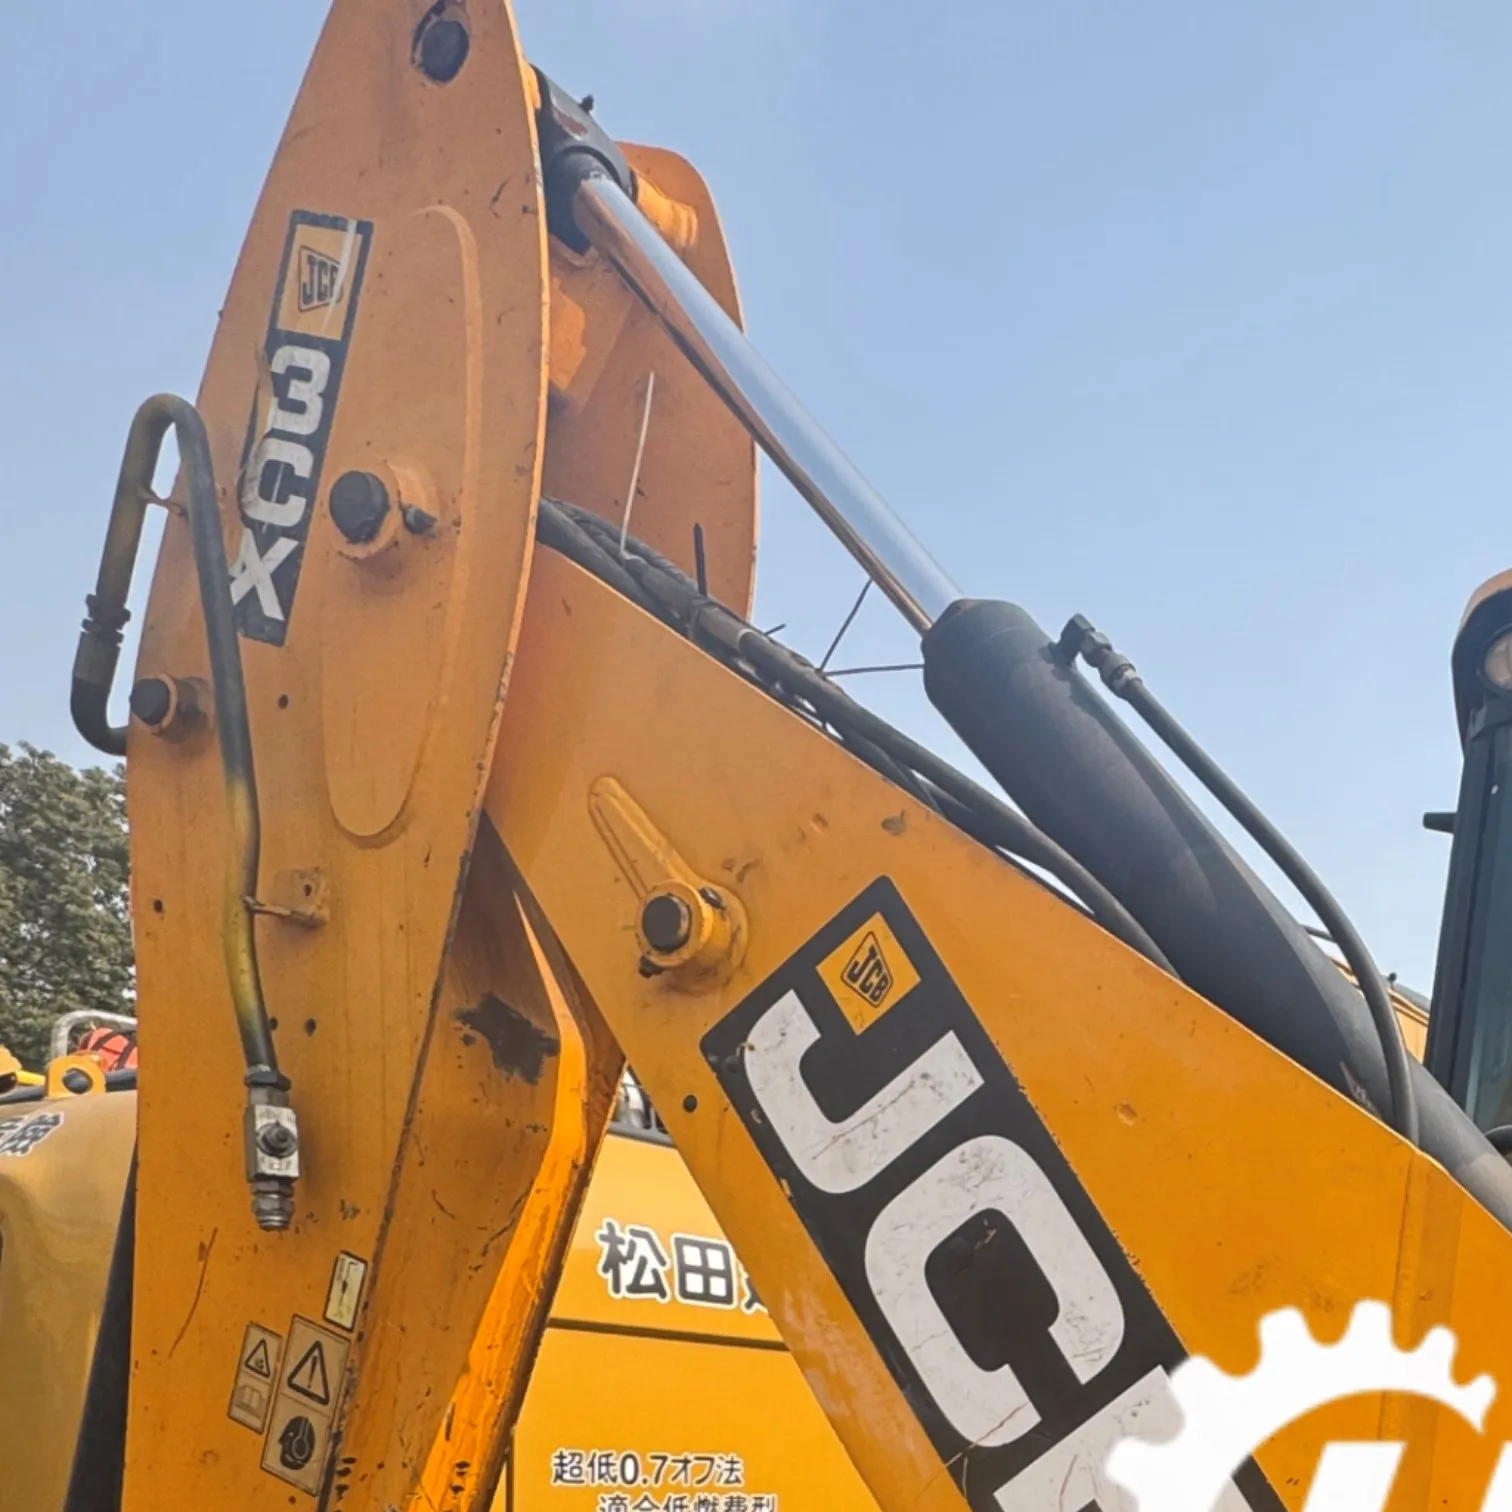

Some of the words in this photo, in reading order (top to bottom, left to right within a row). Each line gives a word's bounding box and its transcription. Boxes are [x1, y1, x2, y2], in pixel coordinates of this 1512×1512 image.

[229, 345, 331, 621] 3CX
[846, 944, 890, 1002] JCB
[598, 1220, 767, 1312] 松田
